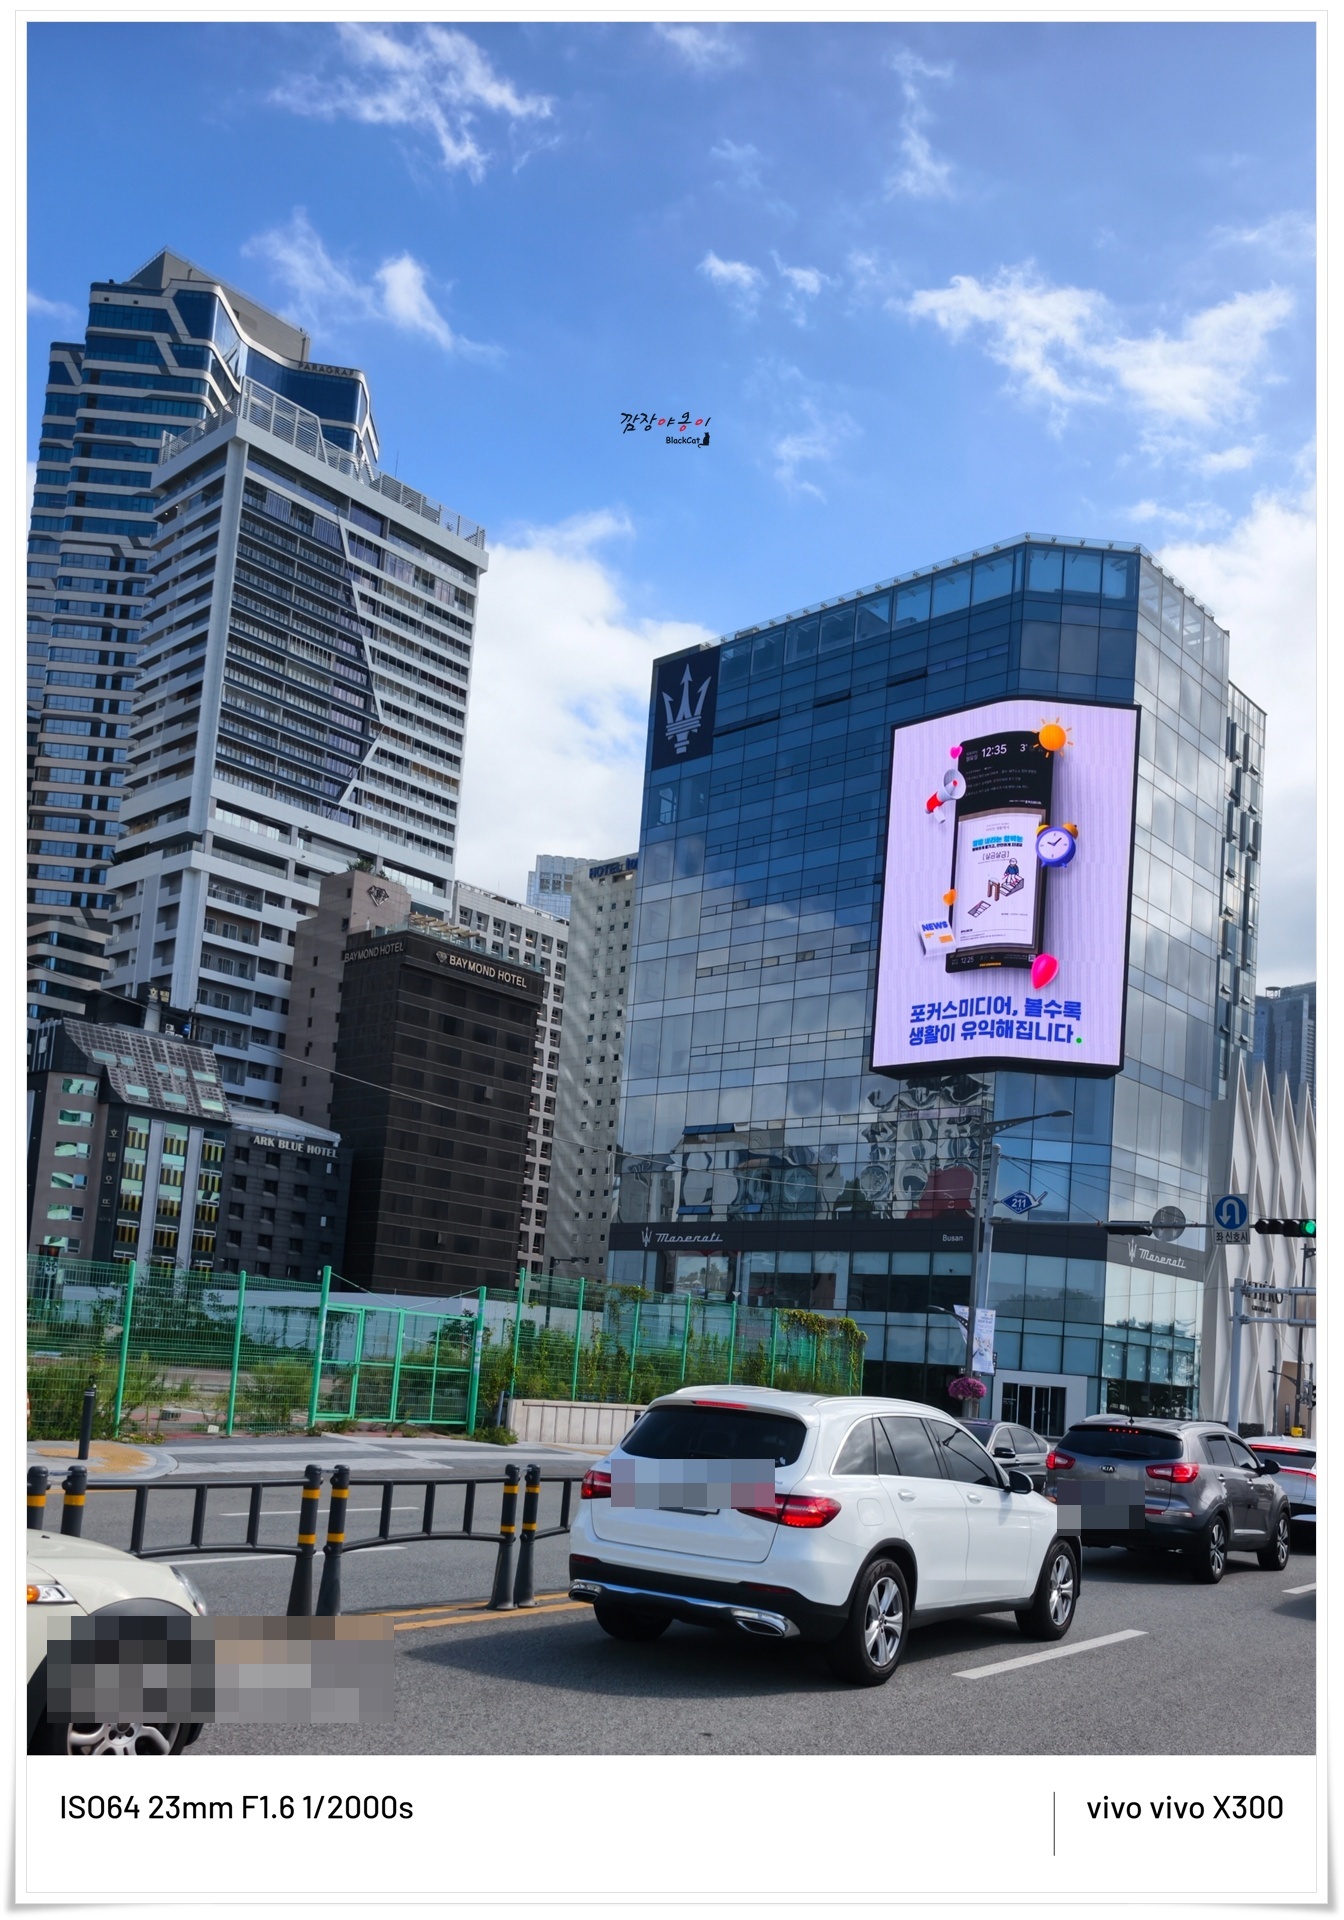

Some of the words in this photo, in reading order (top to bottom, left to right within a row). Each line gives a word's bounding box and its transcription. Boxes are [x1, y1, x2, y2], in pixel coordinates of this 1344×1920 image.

[981, 744, 1007, 758] 12:35
[589, 861, 622, 878] HOTEL
[921, 921, 948, 932] NEWS
[344, 947, 378, 963] BAYMOND
[379, 942, 404, 957] HOTEL
[450, 955, 496, 978] BAYMOND
[497, 971, 527, 988] HOTEL
[910, 996, 1018, 1023] 포커스미디어,
[1024, 997, 1082, 1021] 볼수록
[909, 1023, 956, 1046] 생활이
[961, 1019, 1082, 1043] 유익해집니다.
[253, 1135, 275, 1148] ARK
[278, 1140, 304, 1152] BLUE
[306, 1144, 338, 1158] HOTEL
[1012, 1198, 1026, 1208] 211
[656, 1232, 723, 1242] Maserati
[942, 1234, 964, 1242] Busan
[1139, 1248, 1187, 1269] Maserati
